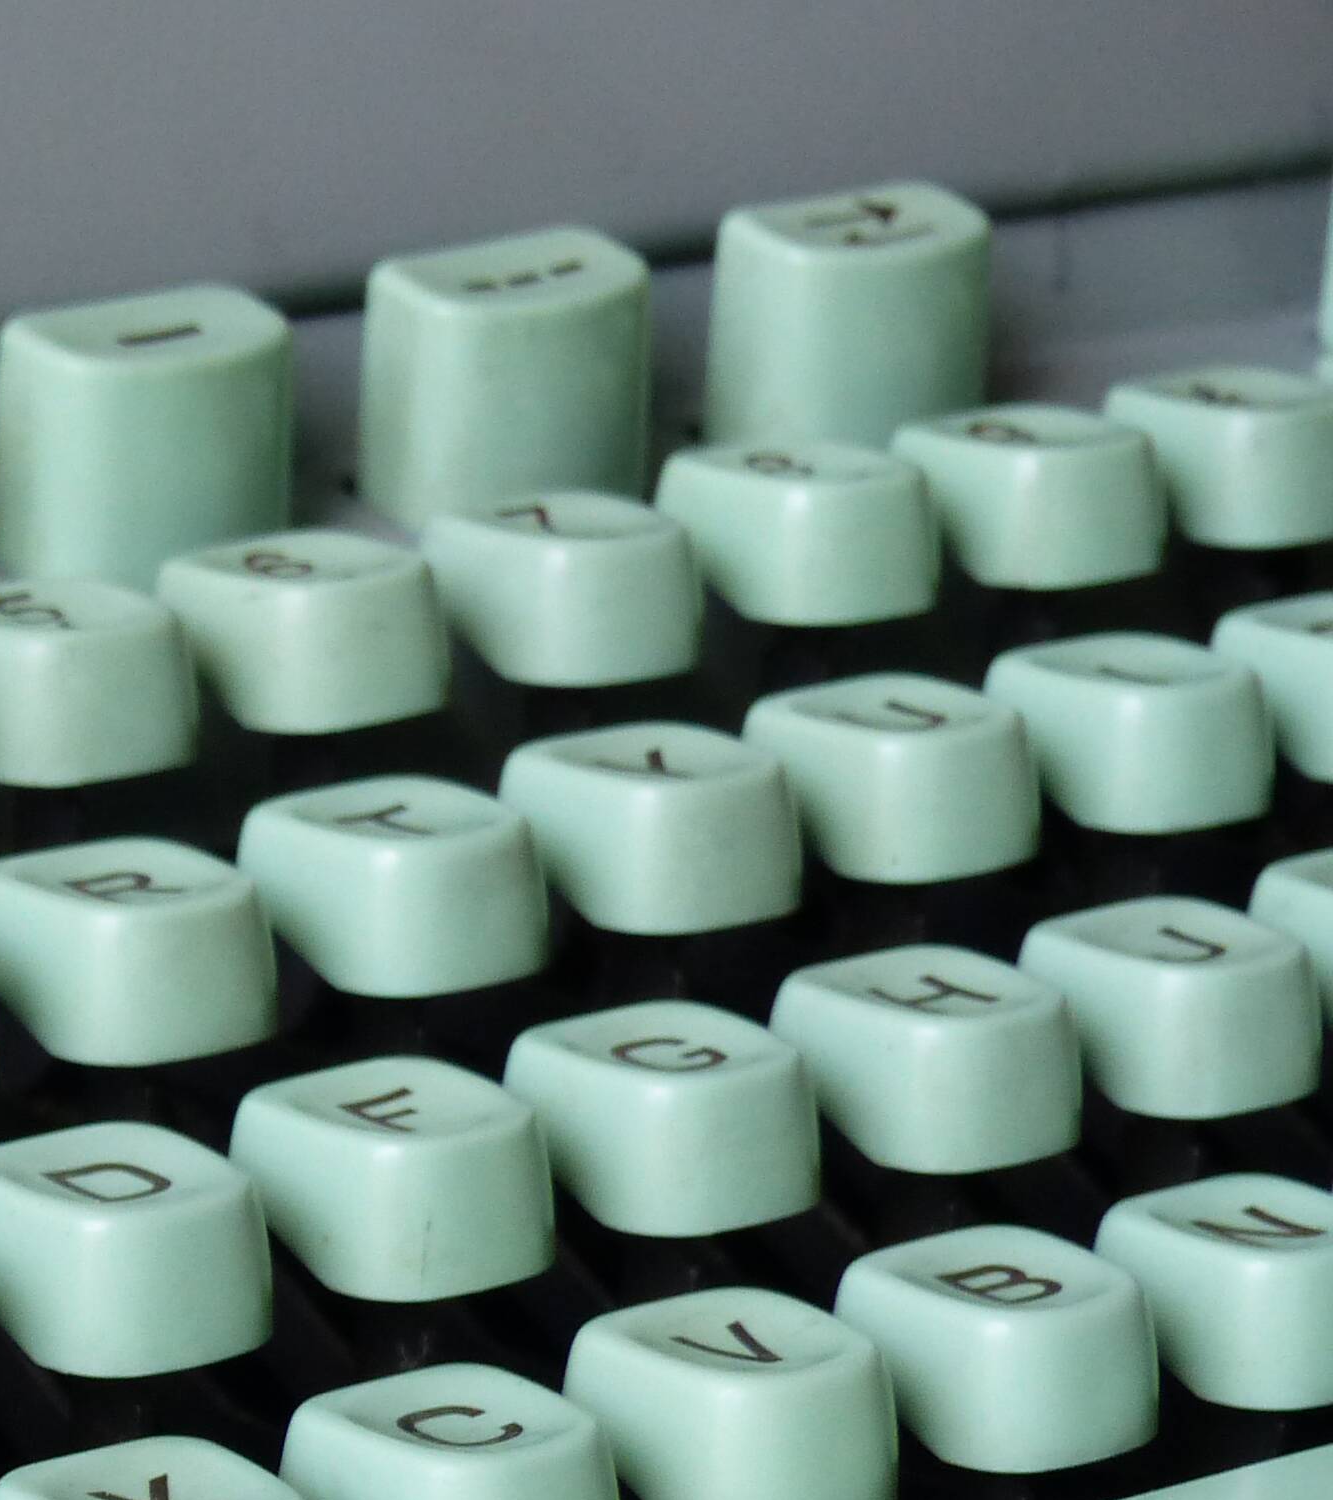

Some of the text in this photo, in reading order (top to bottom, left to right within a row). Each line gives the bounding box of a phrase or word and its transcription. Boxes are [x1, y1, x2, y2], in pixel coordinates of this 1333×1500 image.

[62, 870, 184, 904] R
[1158, 926, 1227, 965] J
[868, 974, 998, 1013] H
[610, 1037, 727, 1072] G
[337, 1087, 419, 1132] F
[40, 1161, 173, 1202] D
[1191, 1206, 1329, 1248] N
[937, 1263, 1063, 1302] B
[669, 1321, 783, 1363] V
[395, 1405, 525, 1447] C
